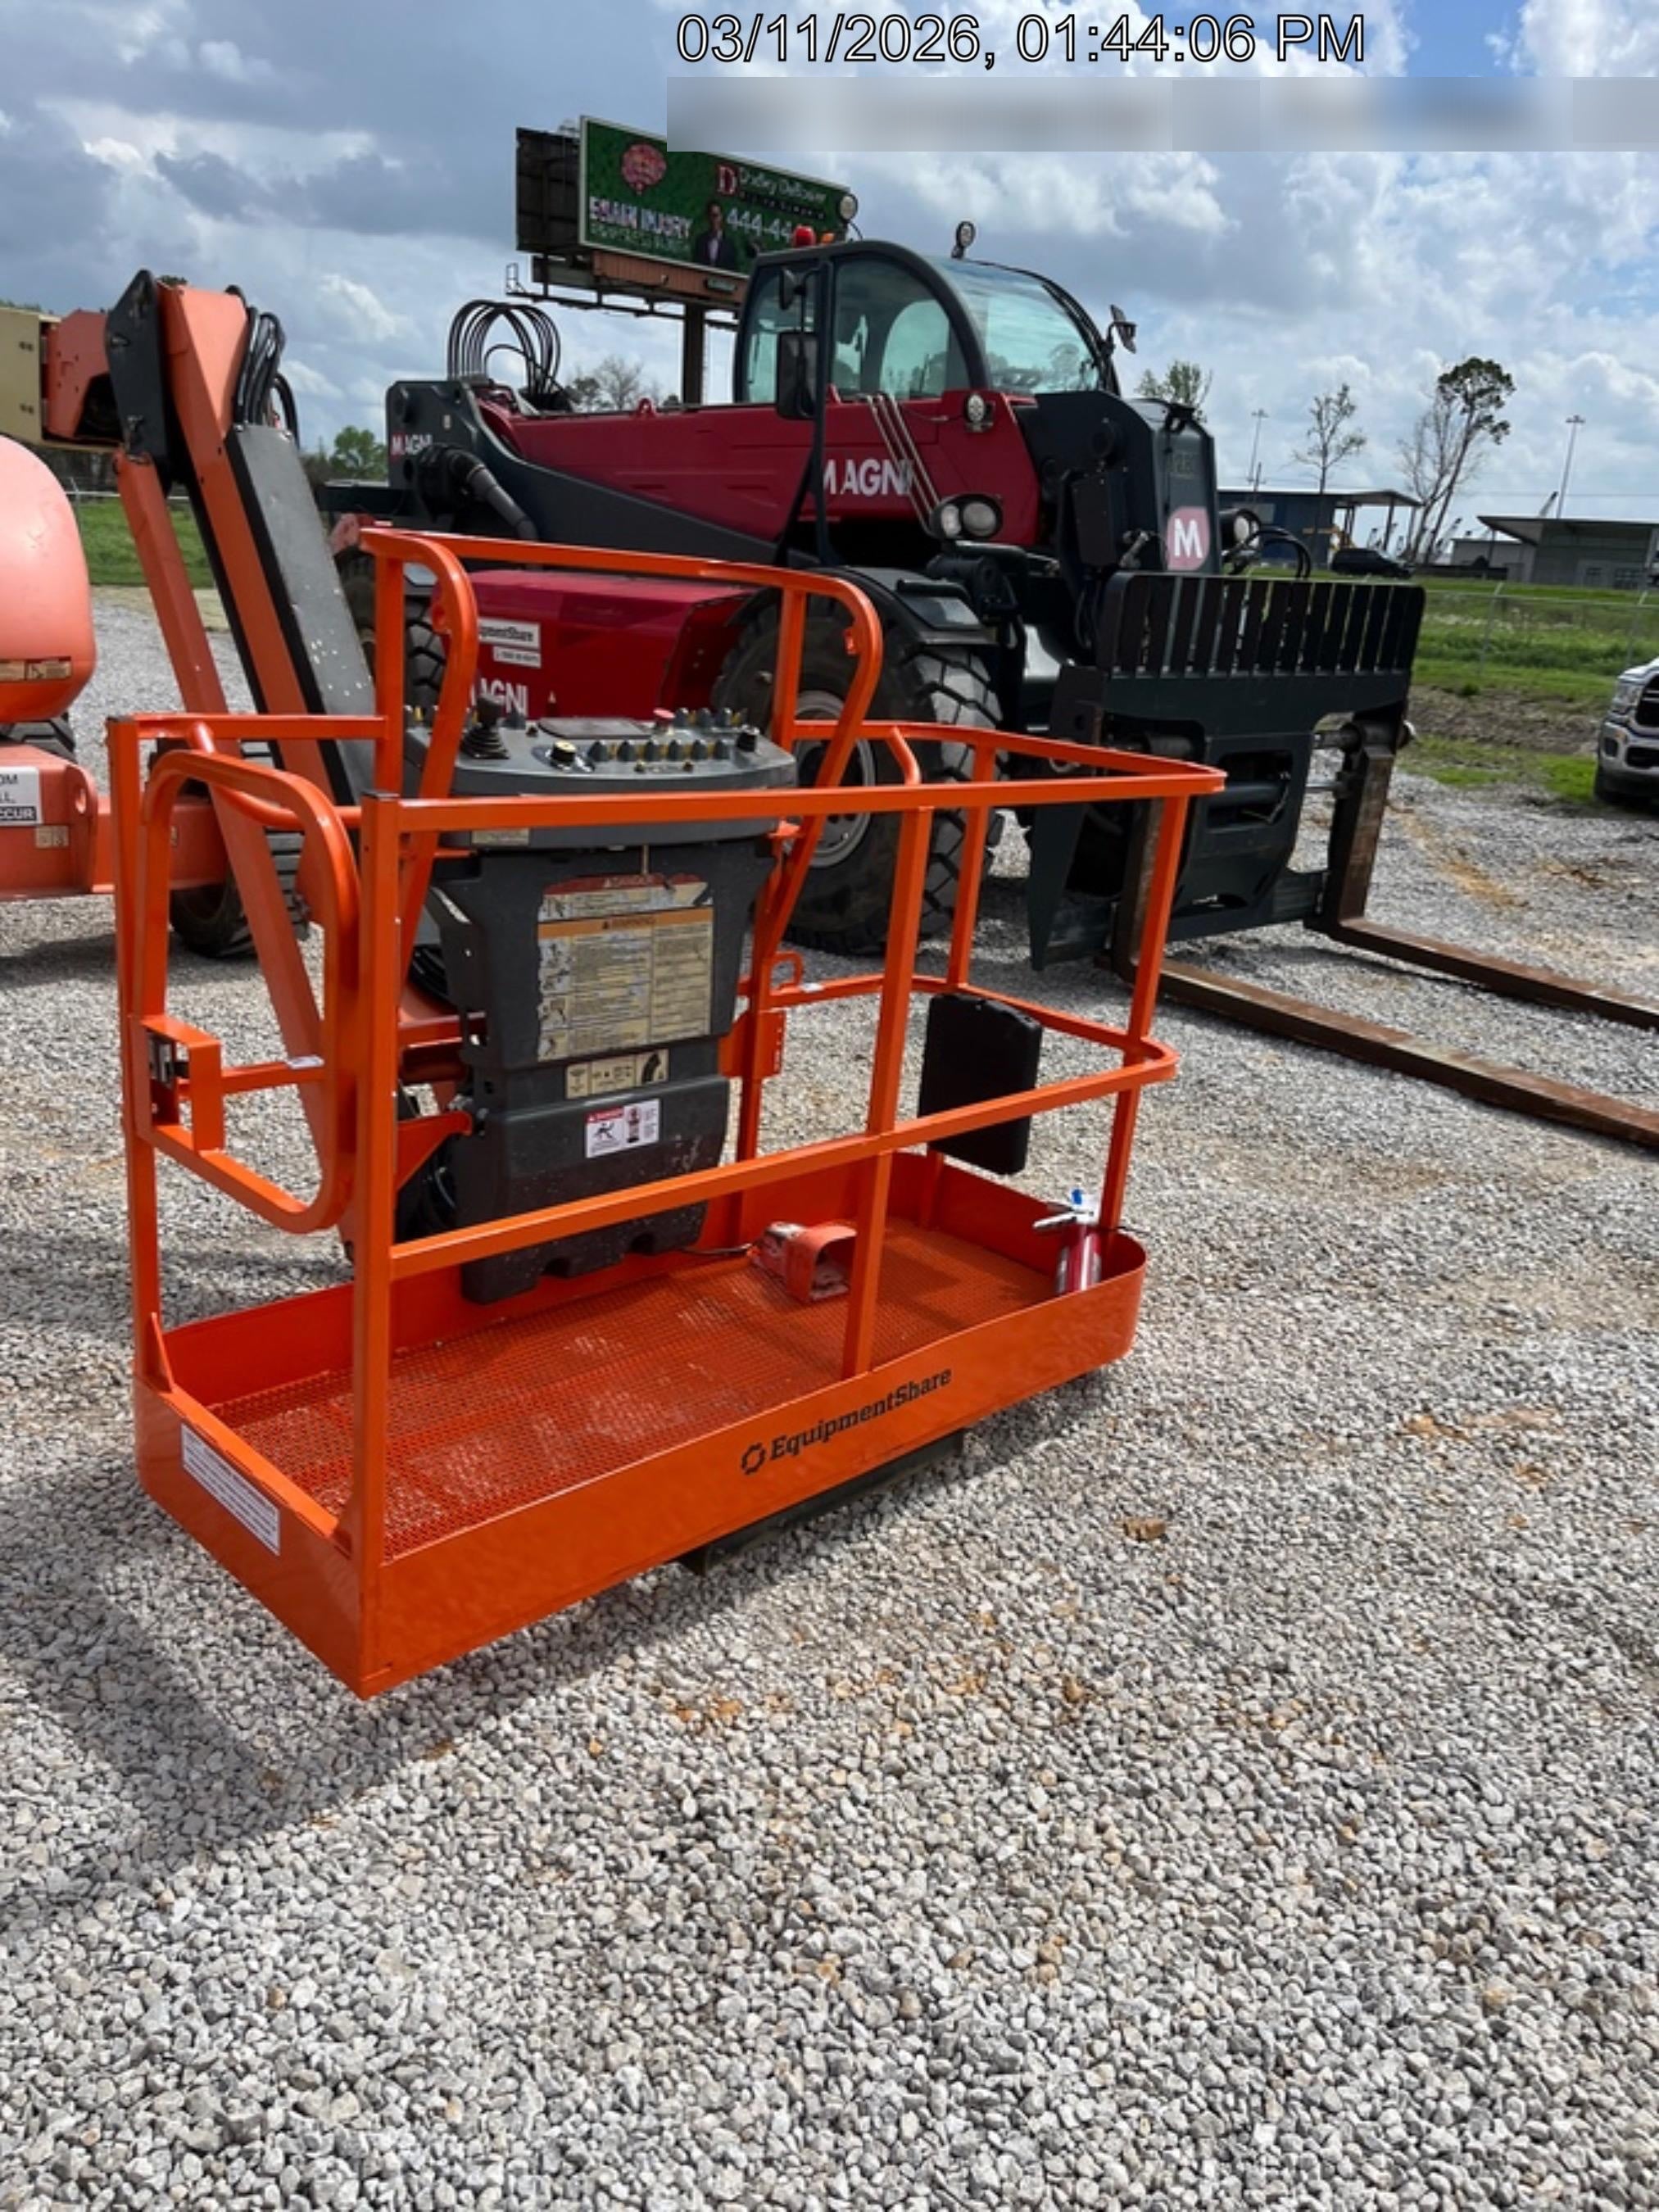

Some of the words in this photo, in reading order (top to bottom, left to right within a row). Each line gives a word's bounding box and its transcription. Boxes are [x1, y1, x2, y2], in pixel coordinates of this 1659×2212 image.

[1174, 517, 1203, 559] M
[471, 678, 528, 717] AGNI
[769, 1368, 952, 1462] EquipmentShare
